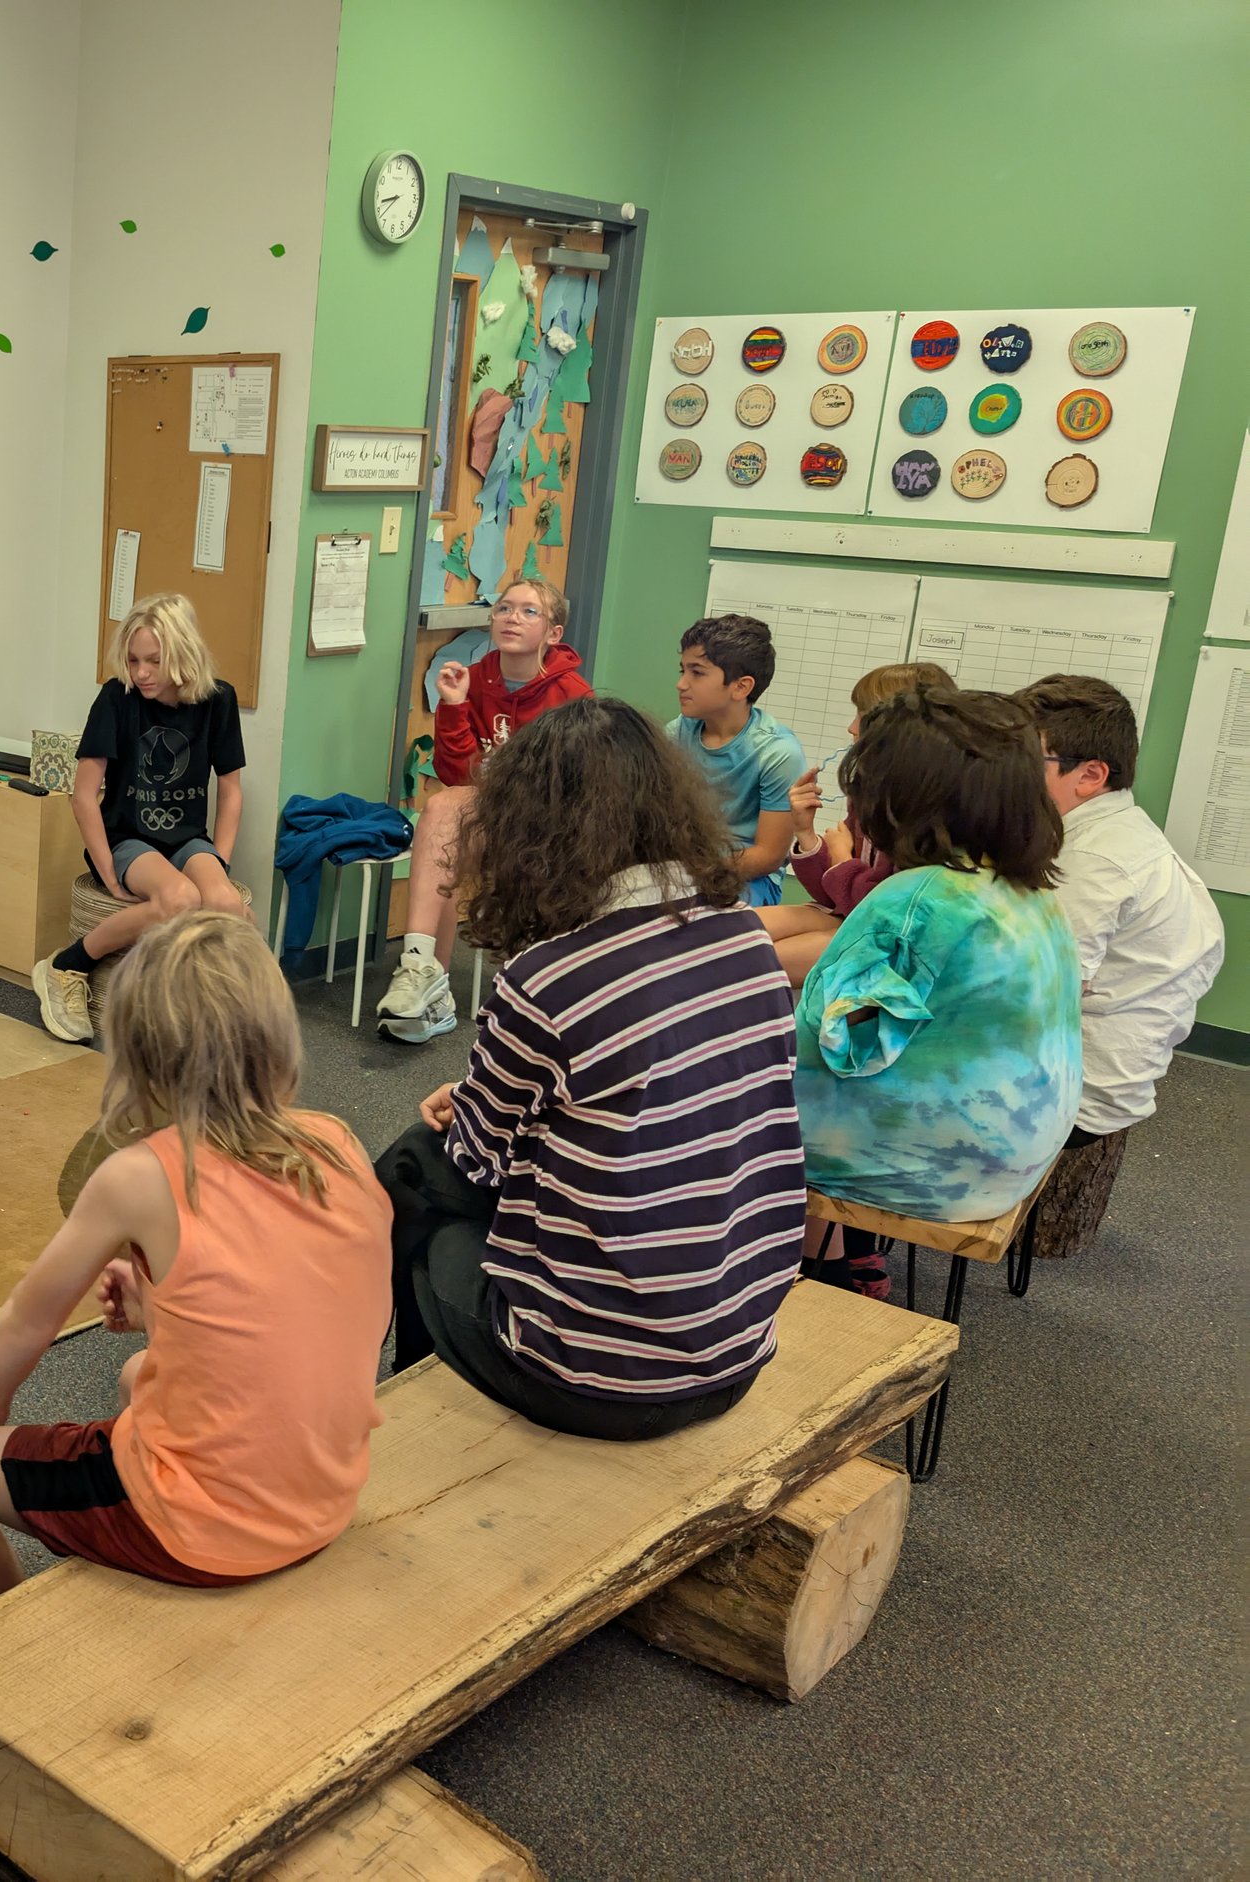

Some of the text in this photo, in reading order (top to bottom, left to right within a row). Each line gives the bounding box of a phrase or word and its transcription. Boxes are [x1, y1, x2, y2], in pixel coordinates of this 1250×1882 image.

[396, 160, 402, 170] 12
[411, 178, 415, 187] 2
[413, 194, 416, 203] 3
[382, 219, 386, 228] 7
[400, 221, 404, 230] 5
[391, 224, 395, 233] 6
[329, 438, 355, 470] Heroes
[360, 441, 370, 462] do
[373, 441, 391, 462] hard
[344, 469, 399, 479] ACTON ACADEMY COLUMBUS
[926, 633, 956, 647] Joseph
[1081, 632, 1108, 641] Thursday
[126, 786, 206, 802] PARIS 2024
